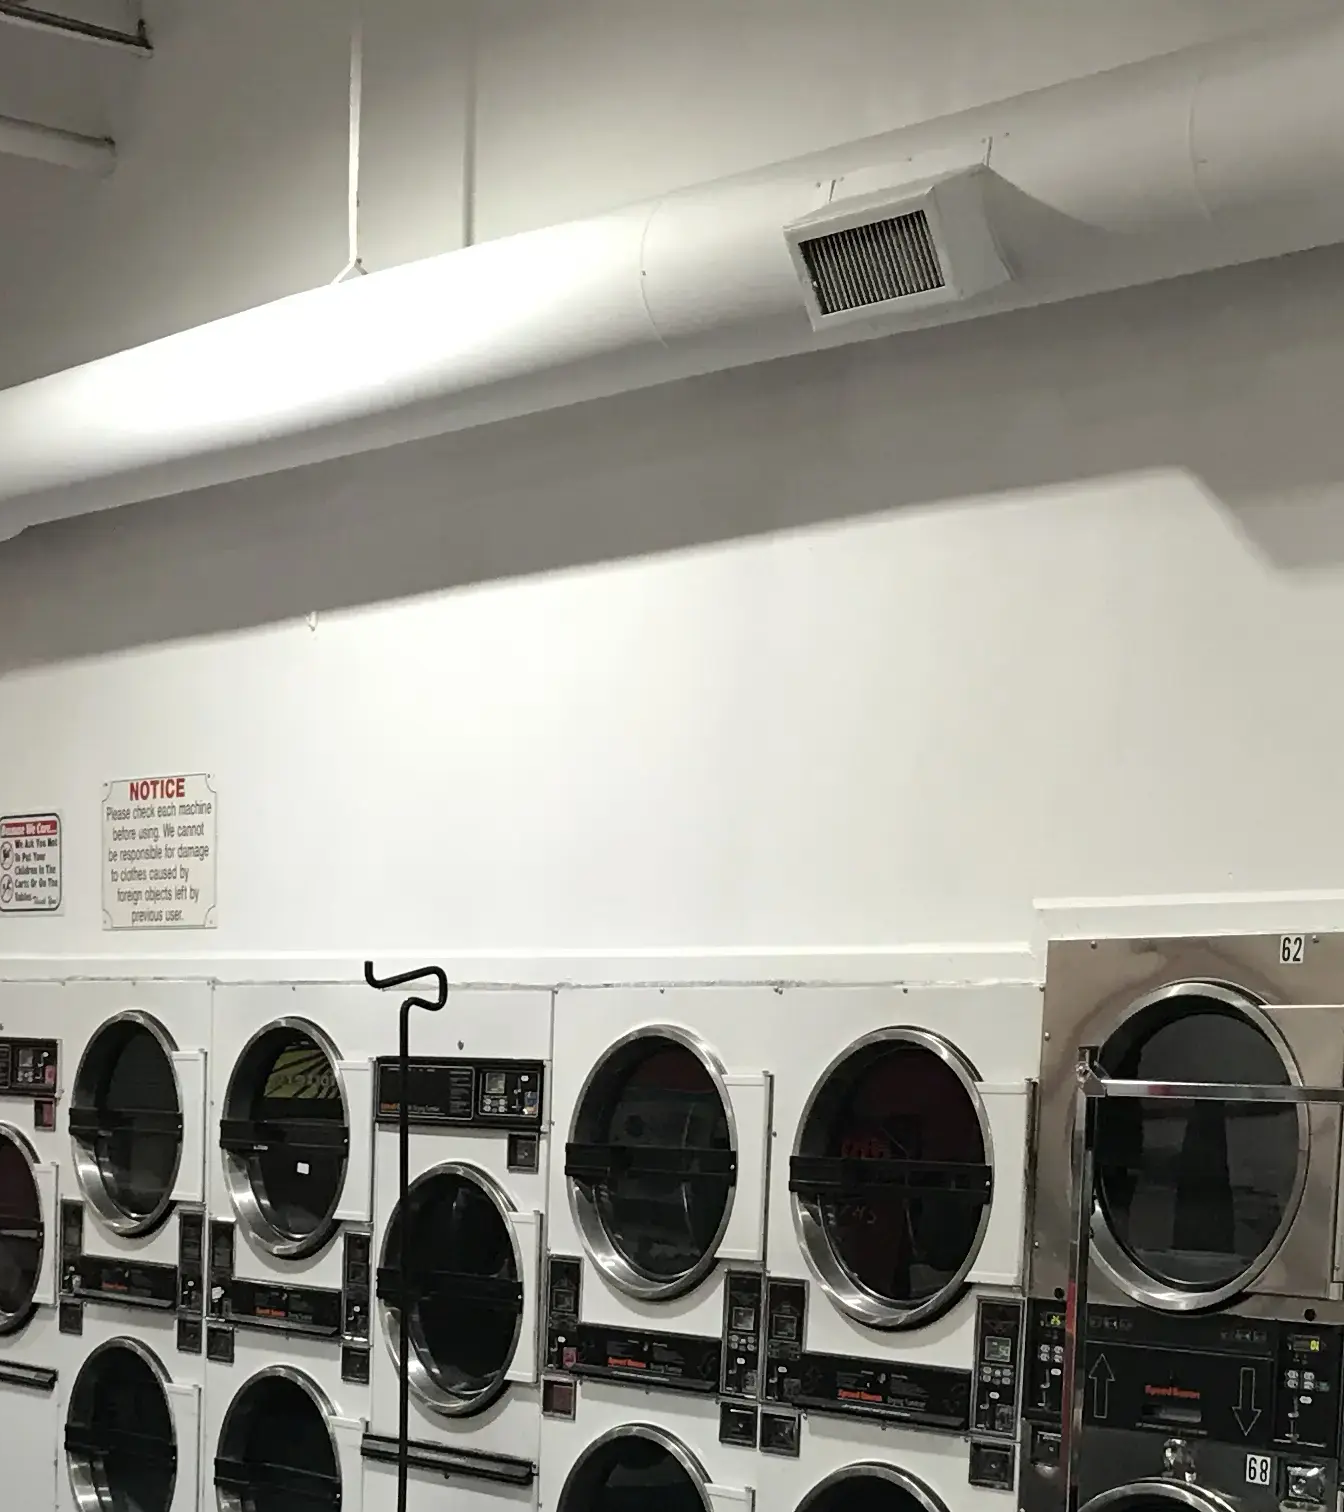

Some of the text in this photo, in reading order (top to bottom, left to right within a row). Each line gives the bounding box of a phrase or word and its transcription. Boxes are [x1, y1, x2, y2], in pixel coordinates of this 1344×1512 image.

[129, 778, 185, 801] NOTICE
[106, 801, 212, 821] Please check each machine
[113, 826, 136, 841] before
[163, 823, 175, 838] We
[177, 822, 204, 837] cannot
[15, 840, 23, 848] We
[25, 839, 34, 848] Ask
[108, 844, 209, 862] be responsible for damage
[15, 865, 37, 875] Children
[111, 864, 189, 882] to clothes caused by
[117, 885, 199, 905] foreign objects left by
[132, 909, 184, 925] previous user.
[1282, 937, 1302, 962] 62
[1248, 1457, 1269, 1483] 68
